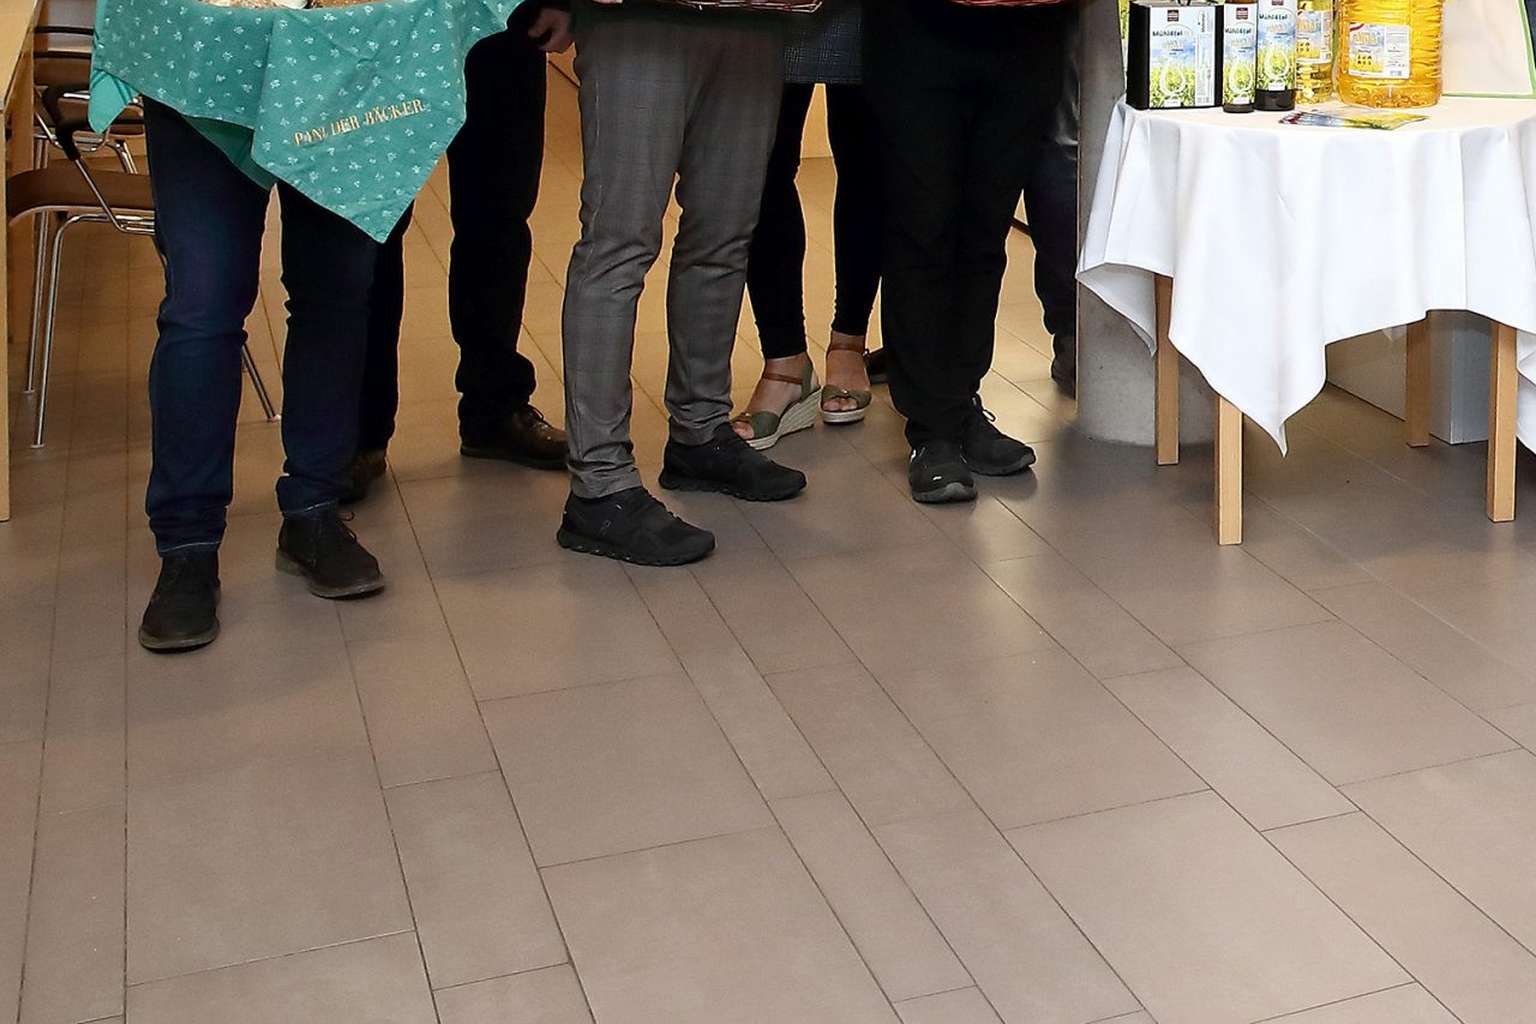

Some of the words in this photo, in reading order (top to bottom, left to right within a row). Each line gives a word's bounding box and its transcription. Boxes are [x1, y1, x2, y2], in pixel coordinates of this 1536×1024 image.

[294, 126, 328, 145] PANI
[331, 115, 360, 136] DER
[364, 98, 425, 126] BÄCKER
